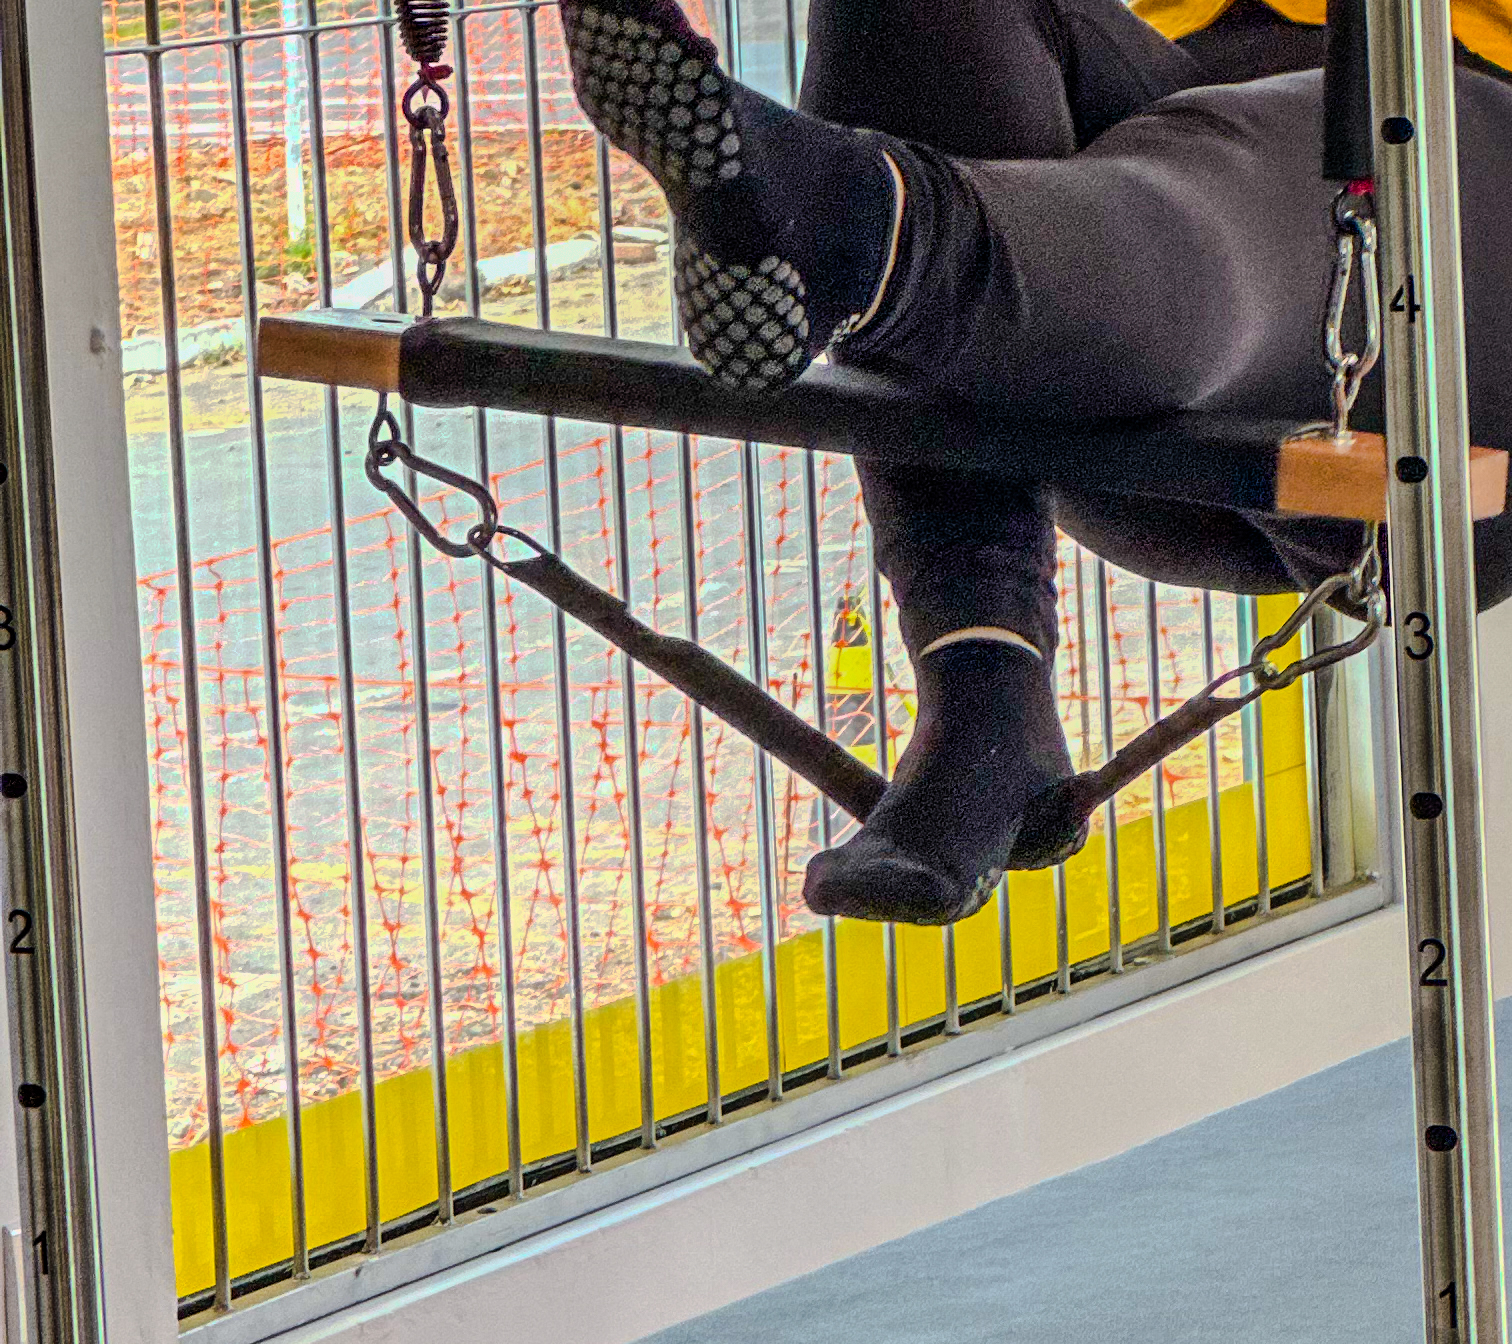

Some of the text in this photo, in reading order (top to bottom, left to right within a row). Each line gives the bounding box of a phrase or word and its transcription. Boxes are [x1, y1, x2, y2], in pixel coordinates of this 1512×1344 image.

[1389, 274, 1421, 324] 4
[1404, 611, 1435, 661] 3
[8, 908, 35, 955] 2
[1417, 938, 1448, 987] 2
[32, 1230, 49, 1275] 1
[1438, 1281, 1458, 1330] 1
